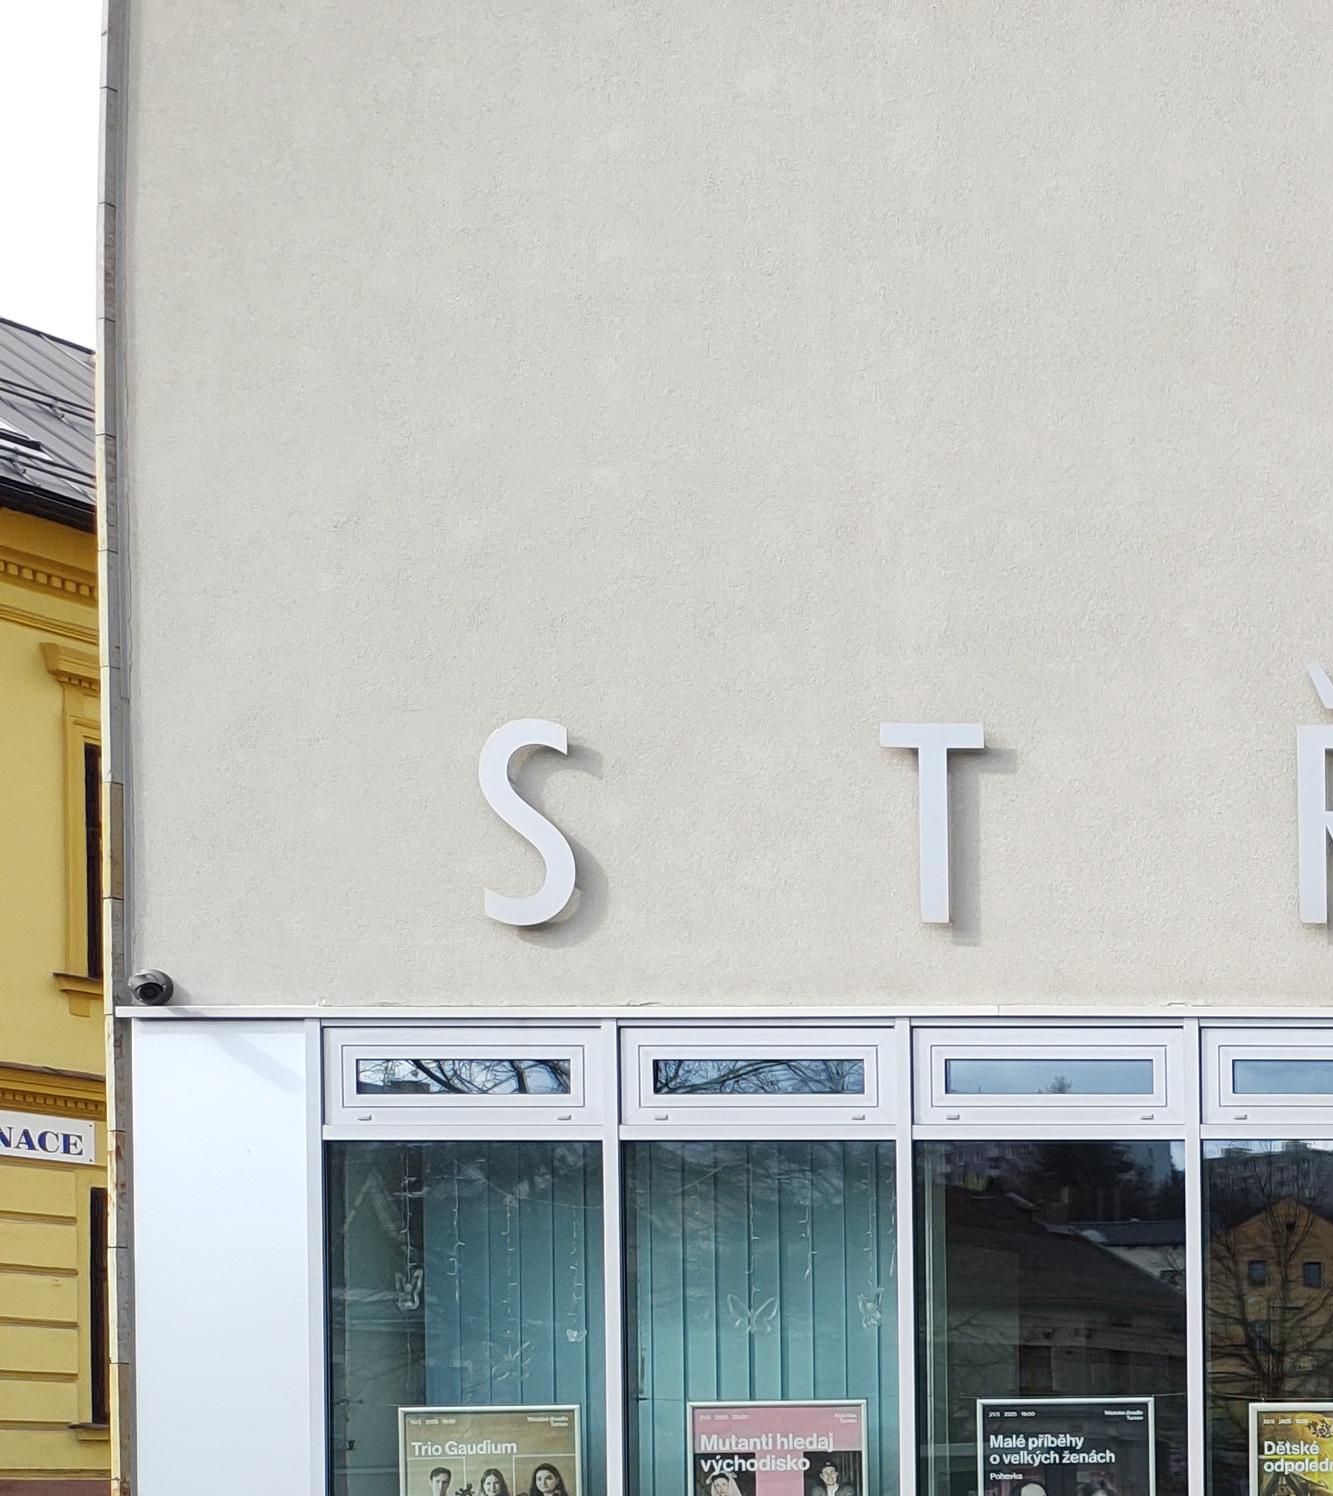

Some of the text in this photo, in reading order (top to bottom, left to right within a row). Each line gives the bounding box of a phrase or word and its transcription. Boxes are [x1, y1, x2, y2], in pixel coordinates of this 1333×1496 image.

[411, 1440, 518, 1456] Trio Gaudium
[700, 1433, 834, 1452] Mutanti hledaj
[989, 1434, 1084, 1450] Malé příběhy
[1263, 1440, 1320, 1455] Dětské
[700, 1454, 811, 1473] východisko
[989, 1449, 1116, 1467] o velkých ženách
